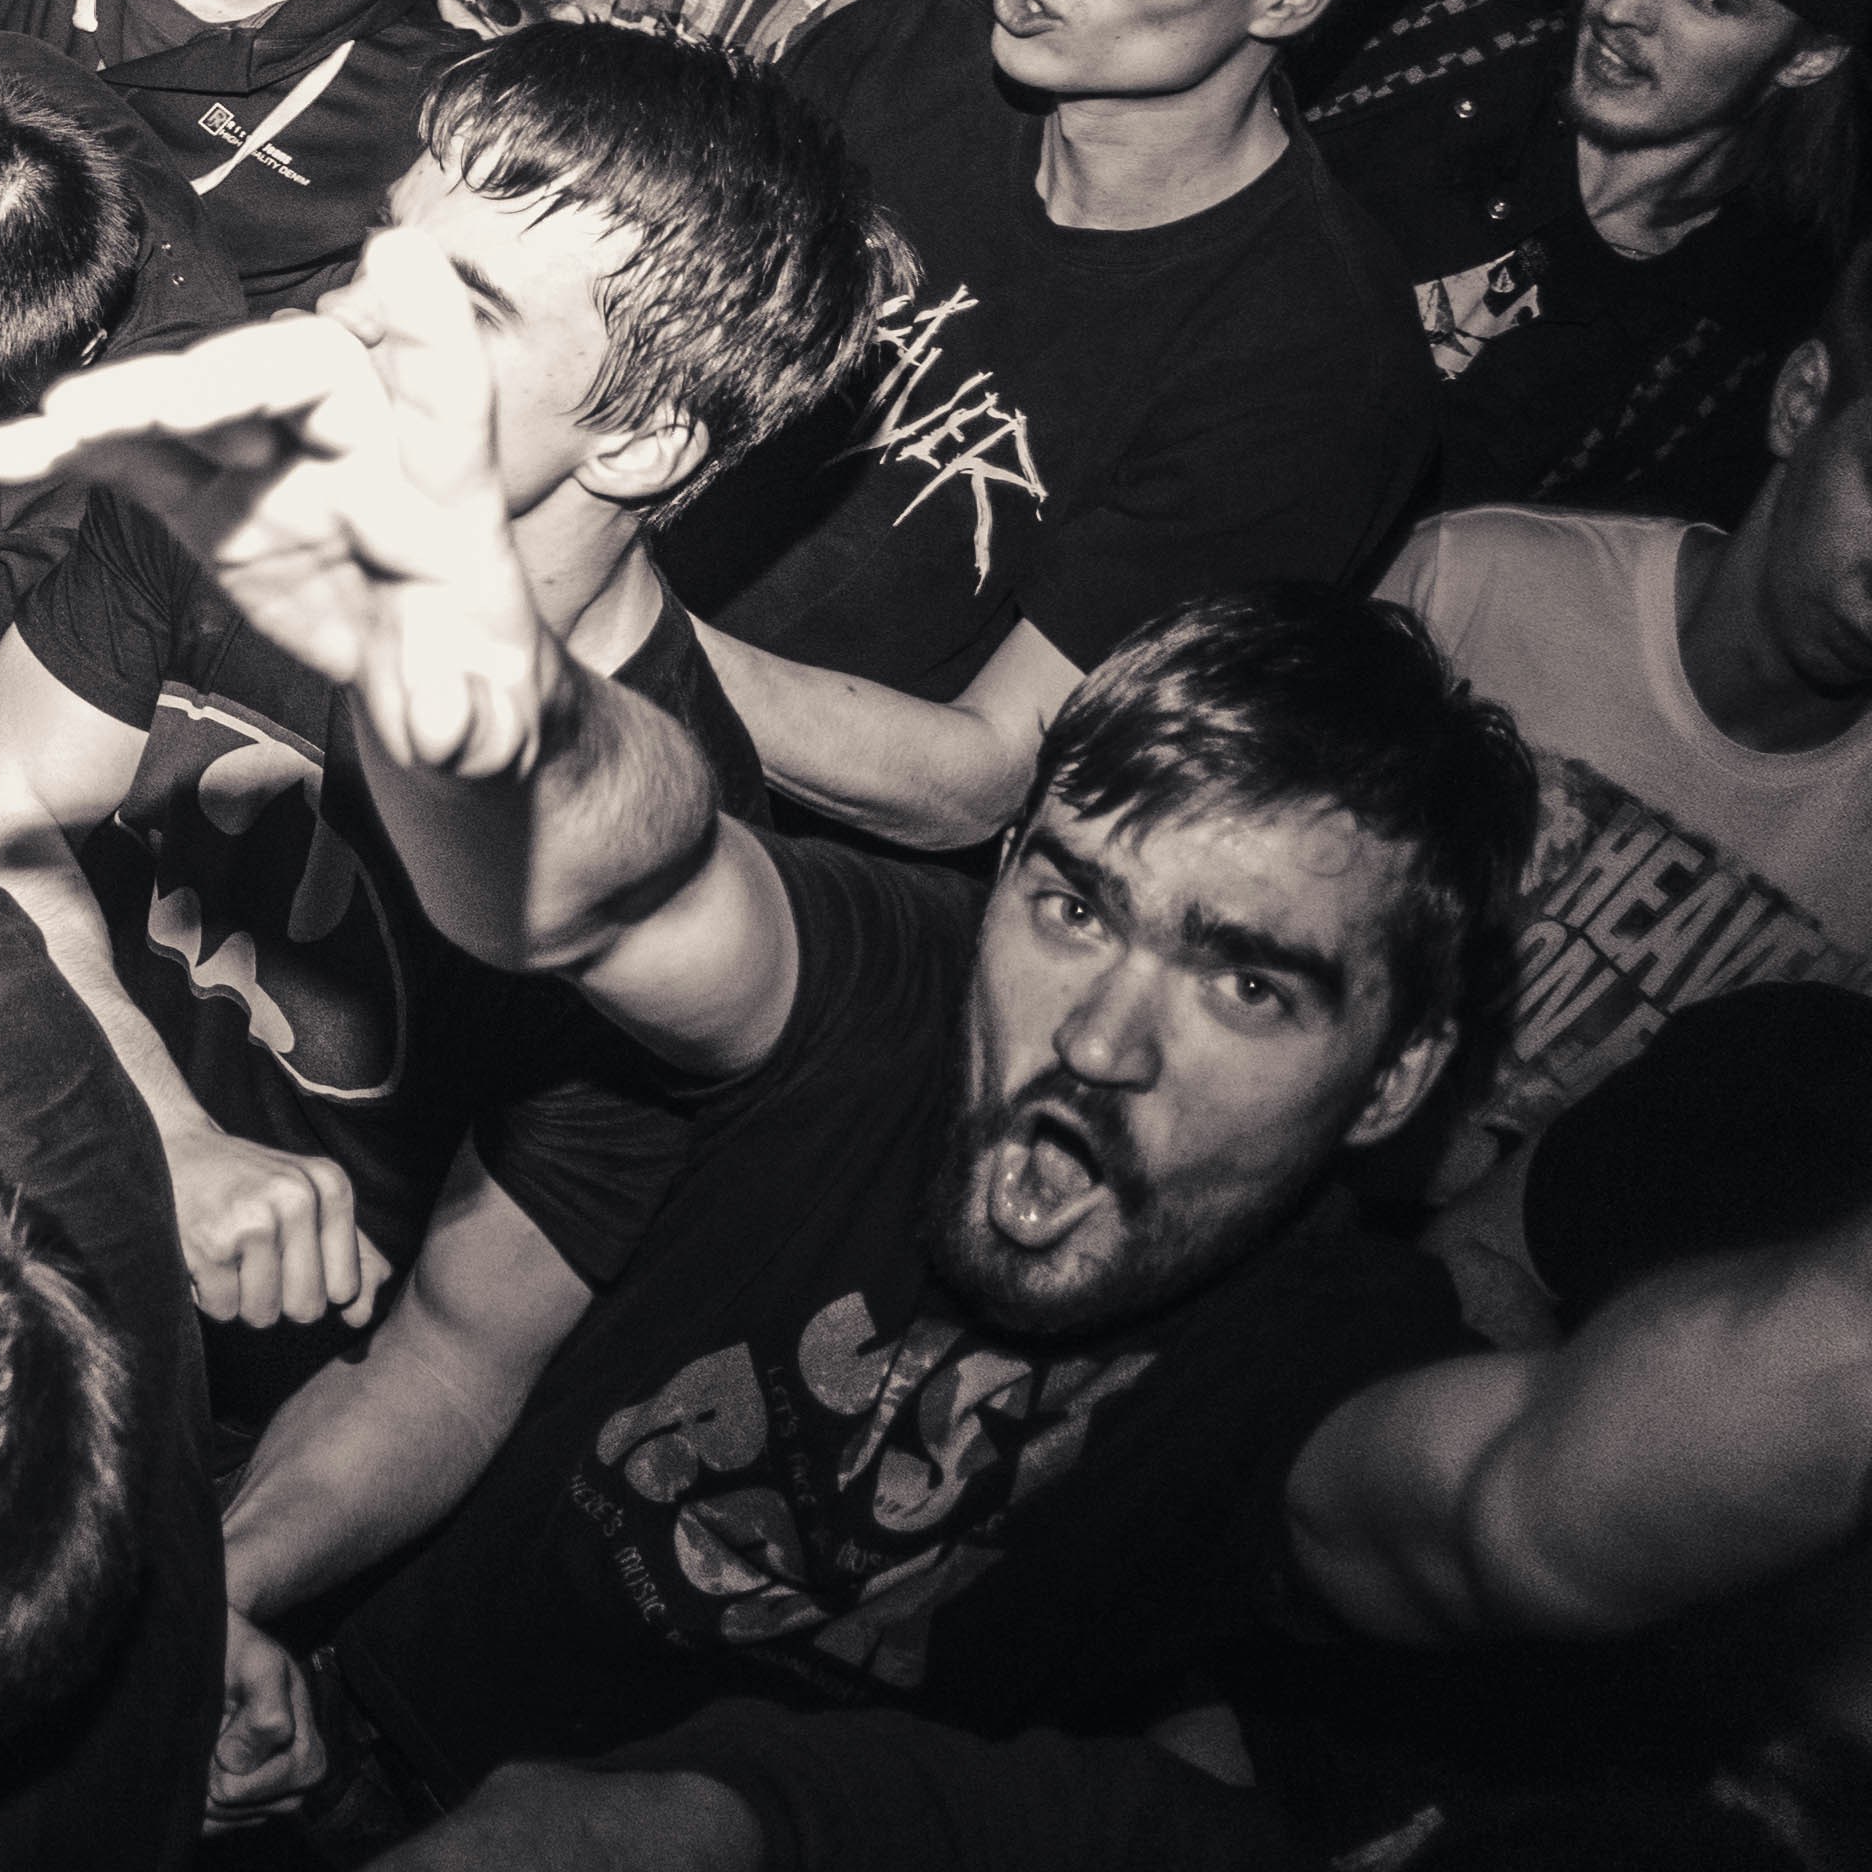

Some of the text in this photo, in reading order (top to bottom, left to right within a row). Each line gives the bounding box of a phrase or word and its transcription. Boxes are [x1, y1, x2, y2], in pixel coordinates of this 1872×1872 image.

[219, 129, 243, 147] HIGH
[251, 150, 280, 170] ALITY
[278, 165, 312, 187] DENIM
[613, 1545, 667, 1623] MUSIC
